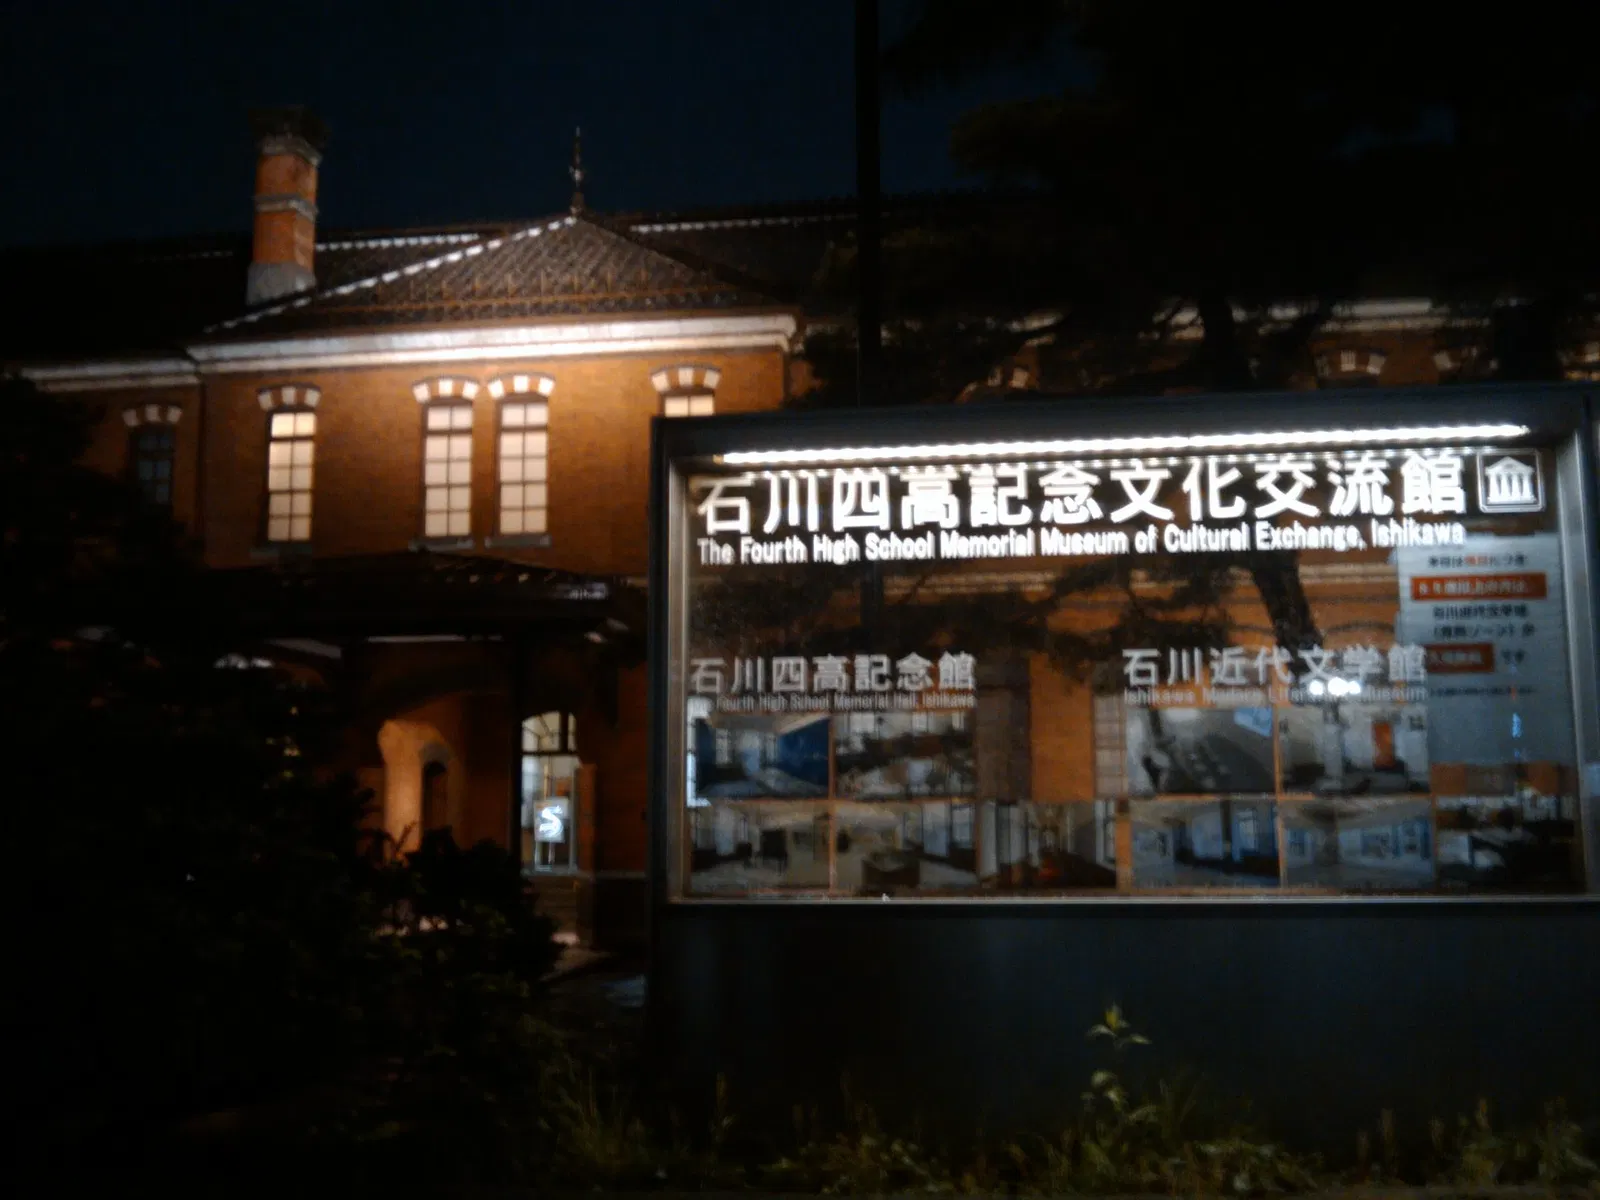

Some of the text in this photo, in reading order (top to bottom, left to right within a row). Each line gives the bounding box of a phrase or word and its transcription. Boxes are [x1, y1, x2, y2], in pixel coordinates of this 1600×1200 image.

[699, 516, 1467, 565] The Fourth High School Memorial Museum of Cultural Exchange, Ishikawa
[1122, 644, 1427, 687] 石川近代文学館
